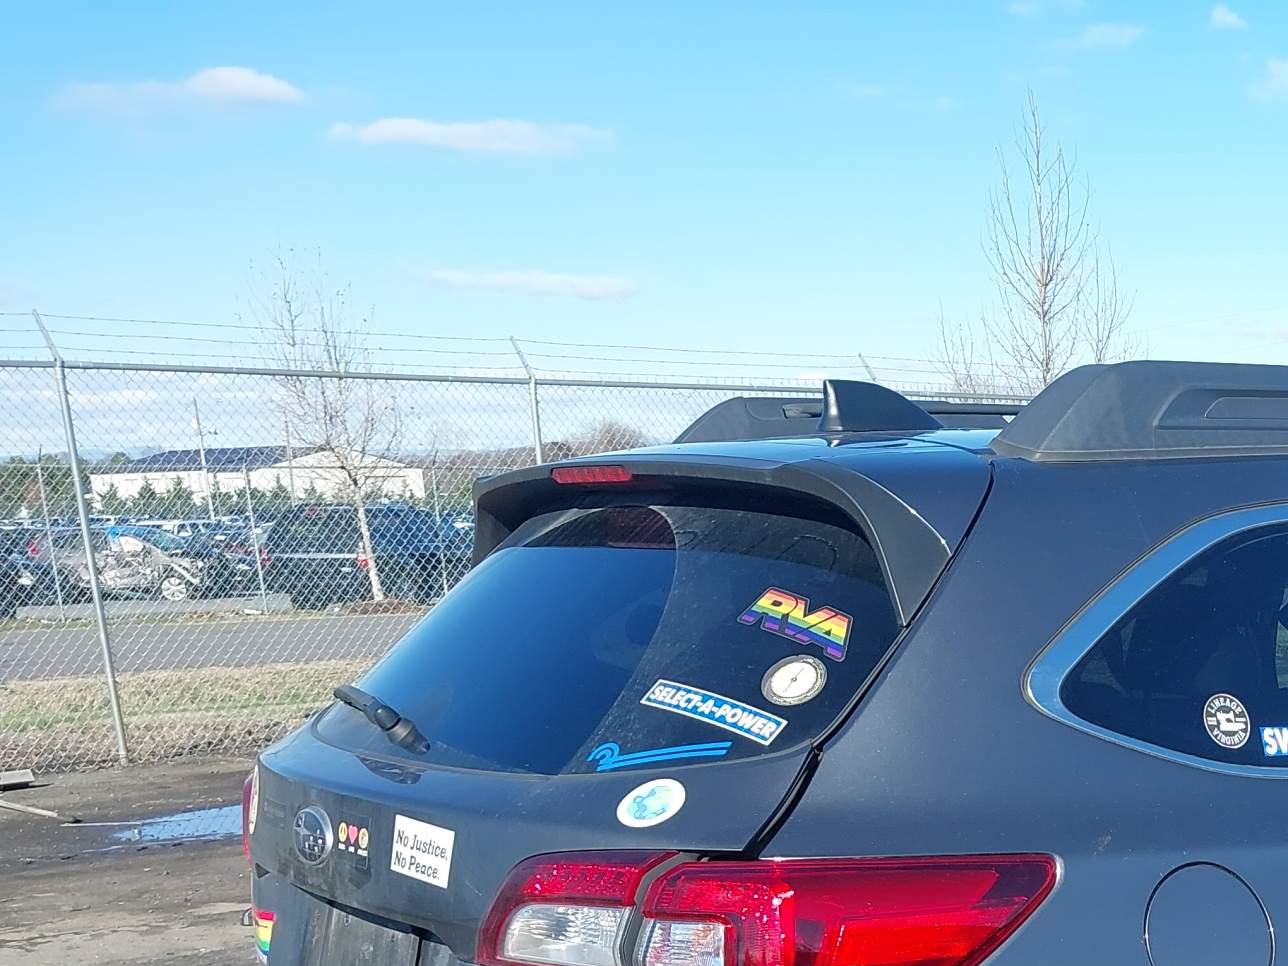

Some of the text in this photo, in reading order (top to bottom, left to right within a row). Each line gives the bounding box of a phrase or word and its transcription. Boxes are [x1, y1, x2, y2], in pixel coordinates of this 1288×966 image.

[741, 588, 850, 659] RVA
[649, 685, 778, 738] SELECT-A-POWER
[1207, 697, 1243, 714] LINEAGE
[1212, 727, 1246, 745] VIRGINIA
[395, 828, 409, 848] No
[393, 850, 406, 869] No
